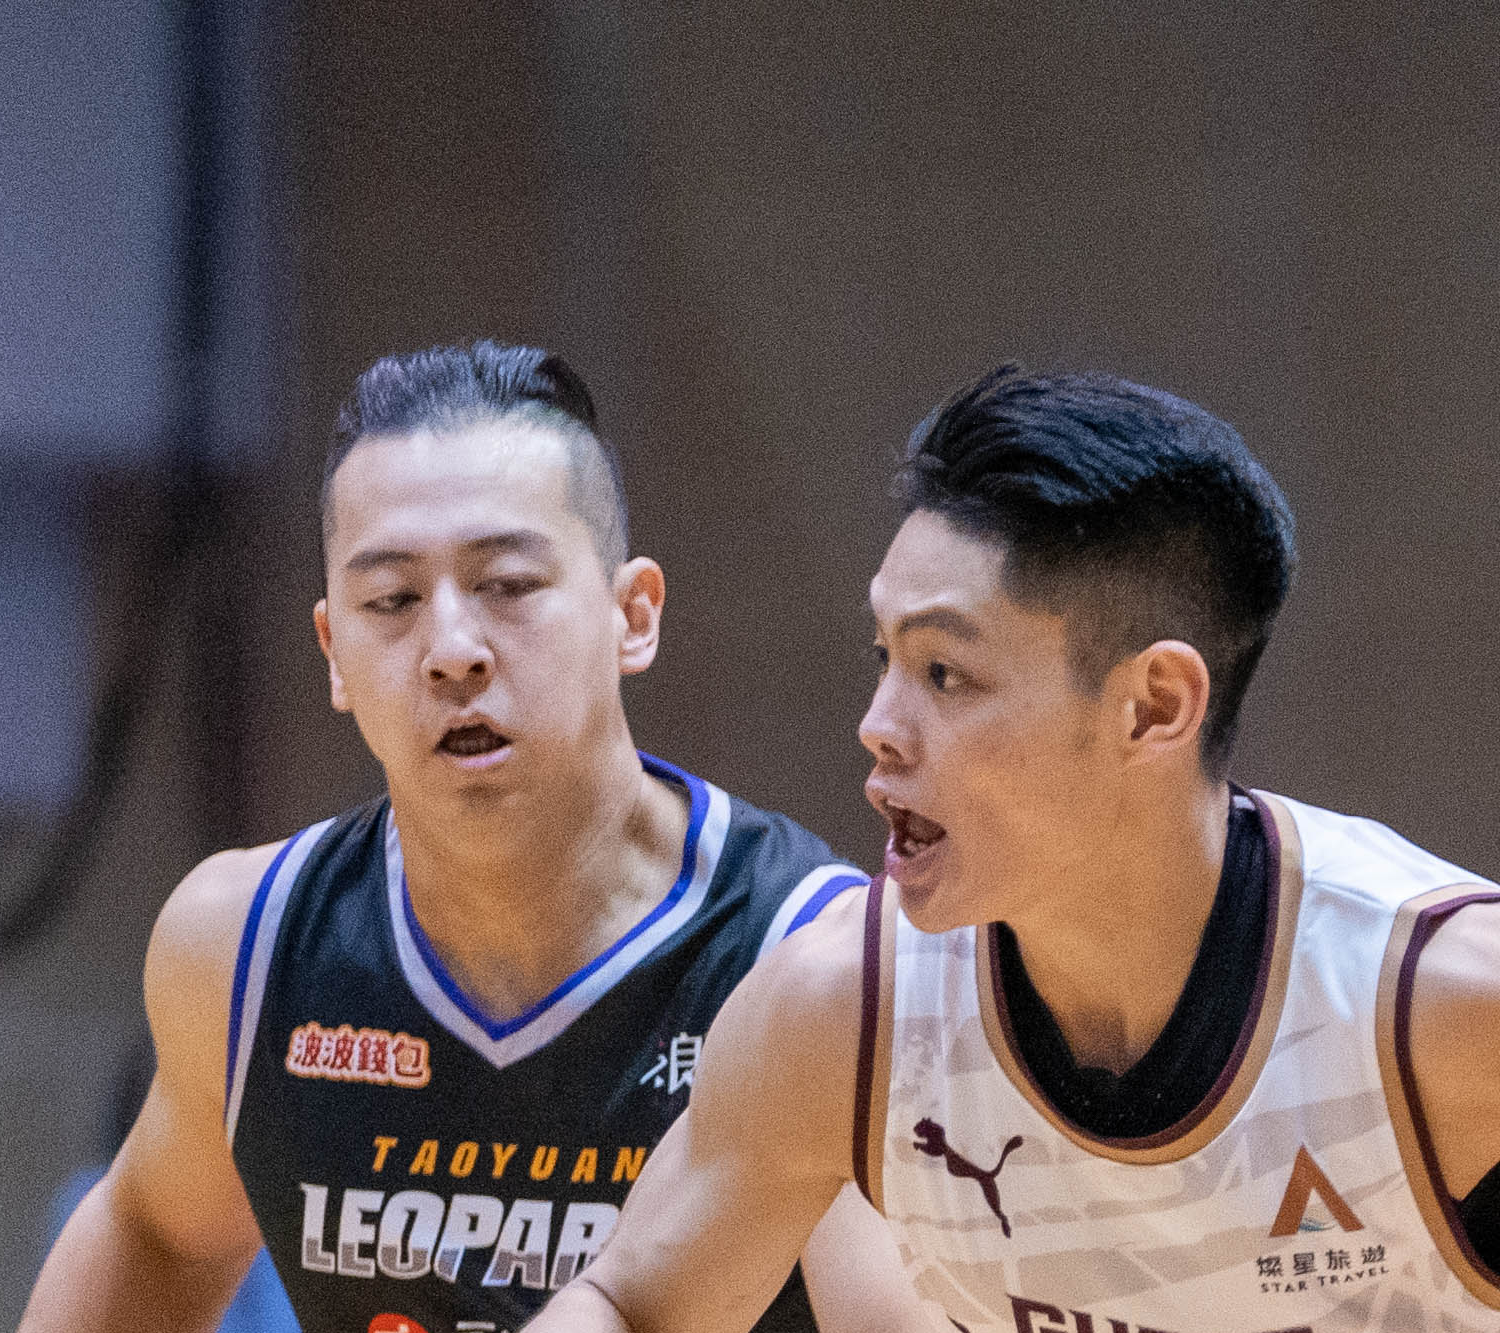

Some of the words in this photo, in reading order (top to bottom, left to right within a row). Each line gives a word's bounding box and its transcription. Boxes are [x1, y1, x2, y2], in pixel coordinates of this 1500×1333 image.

[290, 1025, 428, 1084] 波波錢包
[372, 1136, 648, 1184] TAOYUAN
[1260, 1280, 1308, 1294] STAR
[1317, 1266, 1389, 1287] TRAVEL
